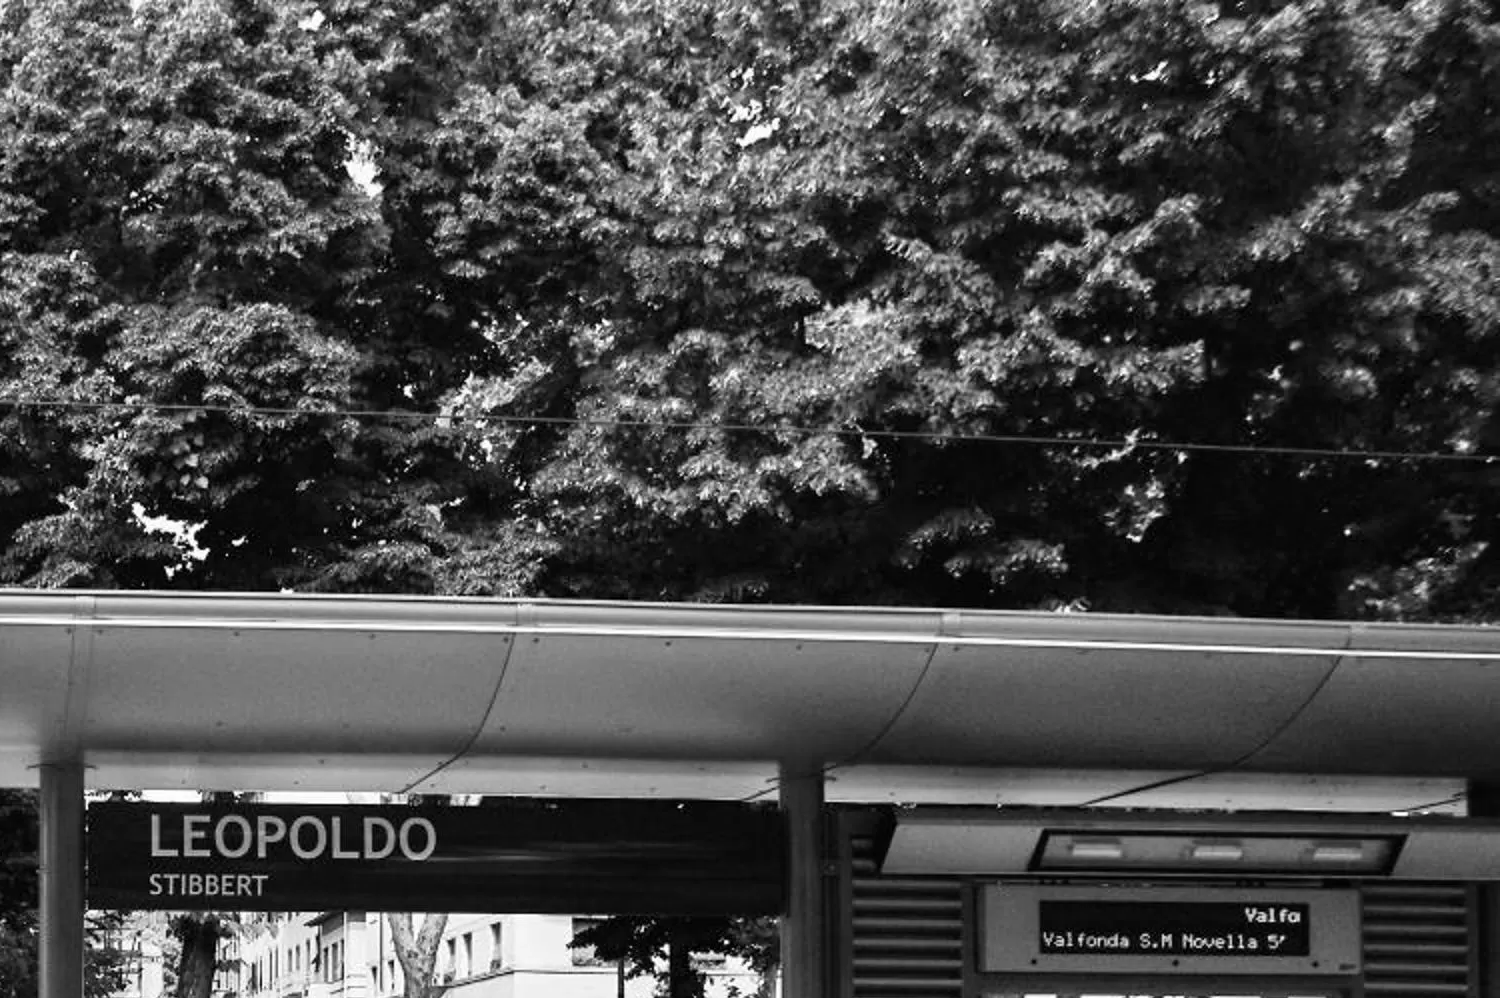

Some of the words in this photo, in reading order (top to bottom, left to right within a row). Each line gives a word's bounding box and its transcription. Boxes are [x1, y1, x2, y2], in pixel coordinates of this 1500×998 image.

[151, 813, 437, 861] LEOPOLDO
[149, 873, 269, 896] STIBBERT
[1042, 931, 1130, 949] Valfonda
[1139, 932, 1173, 949] S.M
[1181, 933, 1258, 949] Novella
